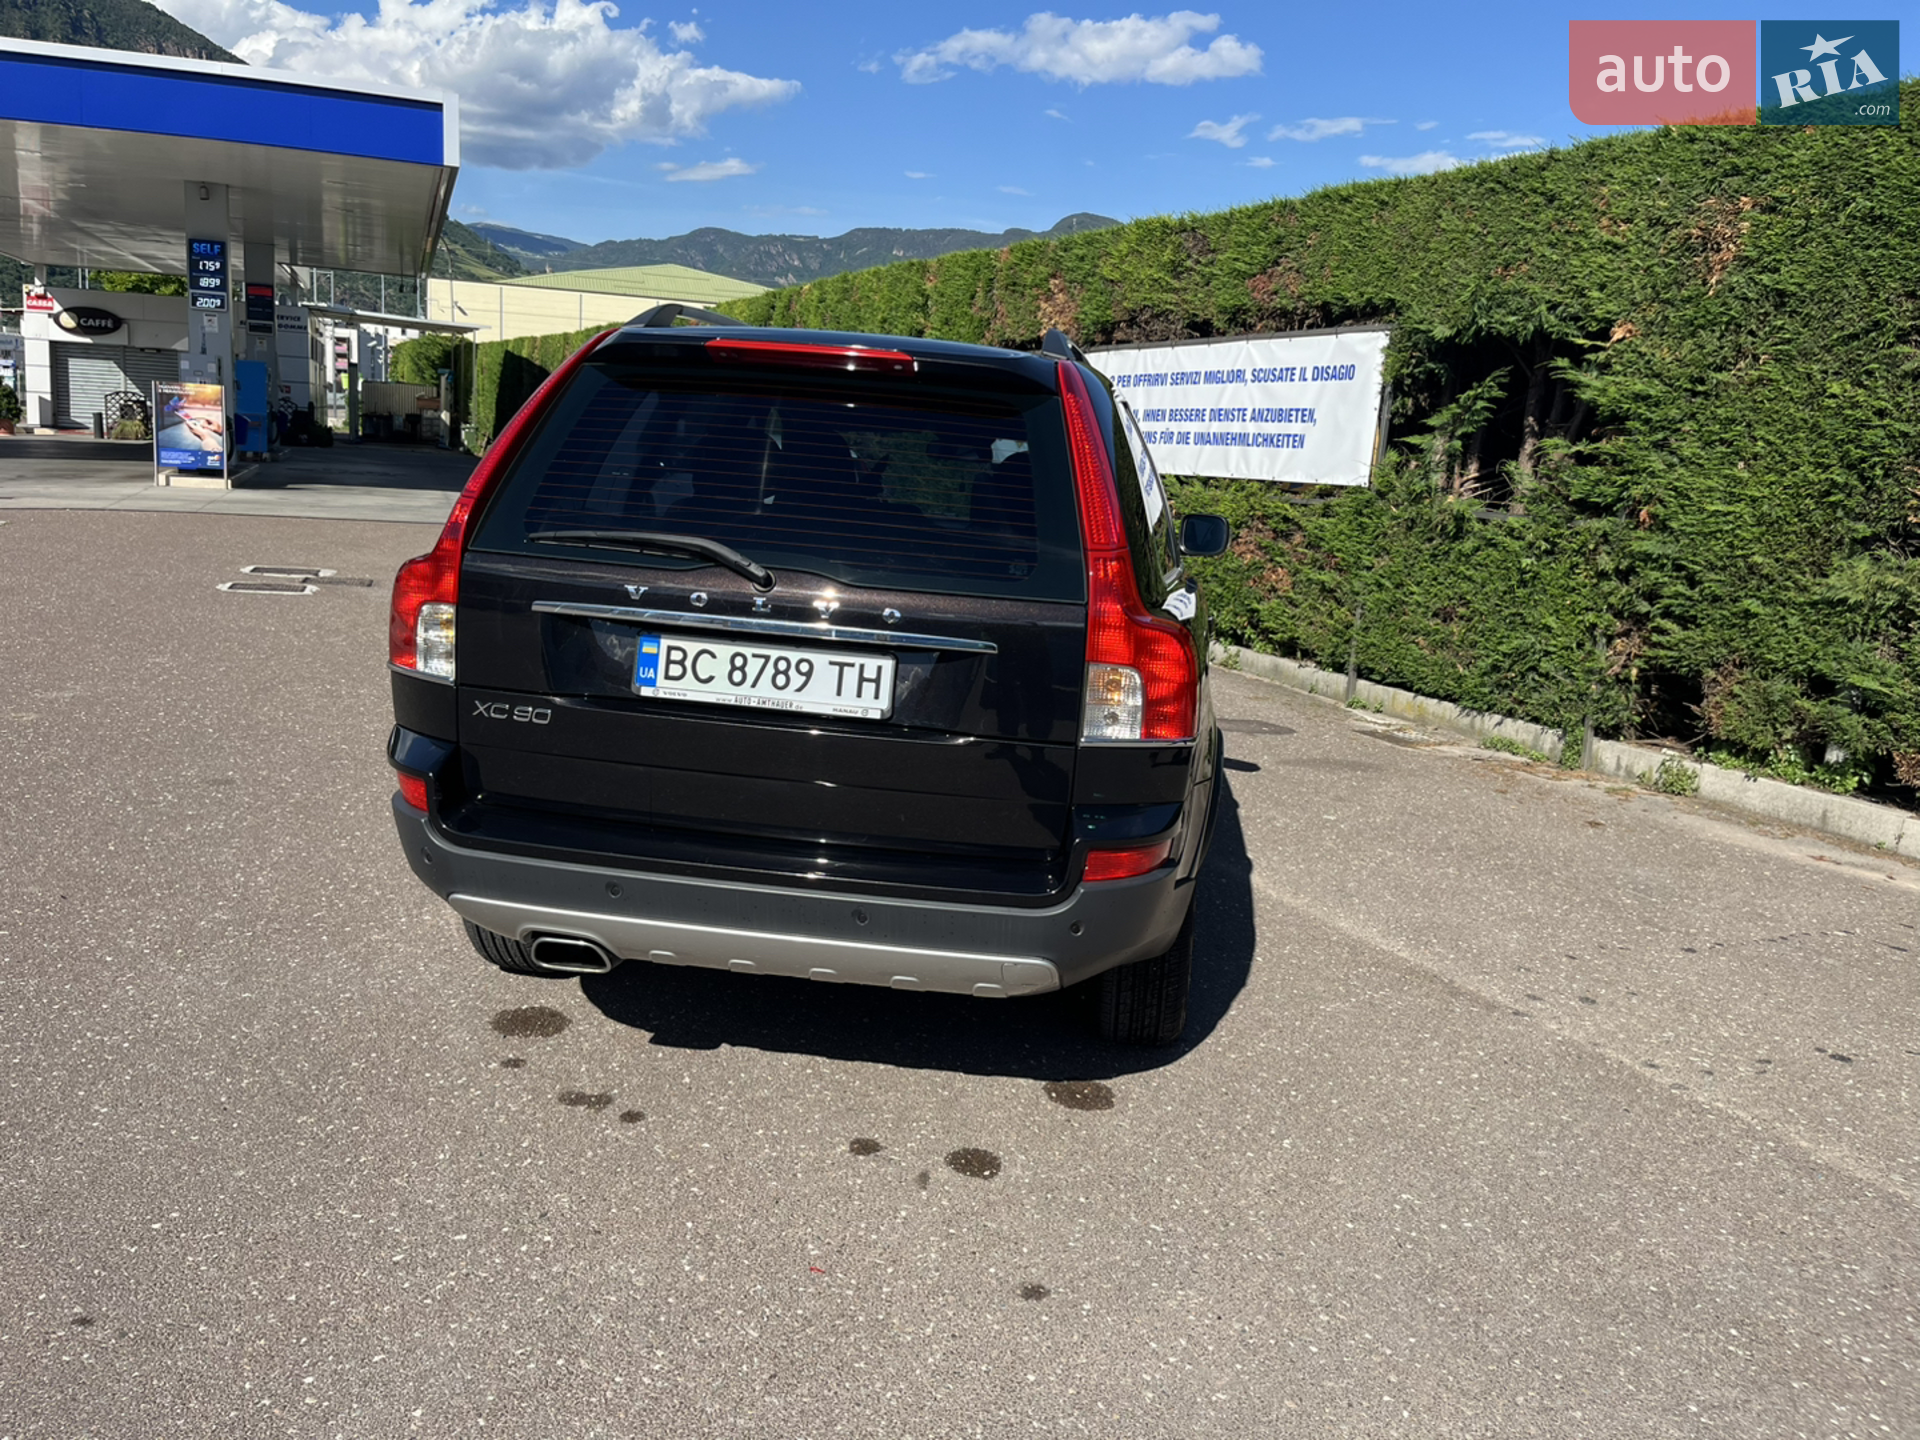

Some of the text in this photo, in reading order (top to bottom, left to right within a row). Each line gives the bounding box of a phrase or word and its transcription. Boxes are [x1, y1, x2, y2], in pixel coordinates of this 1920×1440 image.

[192, 242, 221, 255] SELF
[27, 299, 53, 307] CASSA
[80, 318, 114, 329] CAFFÈ
[1116, 375, 1132, 388] PER
[1133, 372, 1168, 388] OFFRIRVI
[1170, 370, 1202, 386] SERVIZI
[1203, 368, 1248, 387] MIGLIORI,
[1250, 366, 1297, 384] SCUSATE
[1298, 366, 1308, 382] IL
[1311, 363, 1356, 382] DISAGIO
[1142, 408, 1167, 422] IHNEN
[1168, 408, 1207, 422] BESSERE
[1209, 407, 1248, 422] DIENSTE
[1249, 407, 1317, 426] ANZUBIETEN,
[1158, 427, 1175, 445] FÜR
[1176, 431, 1191, 445] DIE
[1193, 431, 1306, 449] UNANNEHMLICHKEITEN
[624, 584, 901, 624] VOLVO
[639, 644, 883, 701] UA BC 8789 TH
